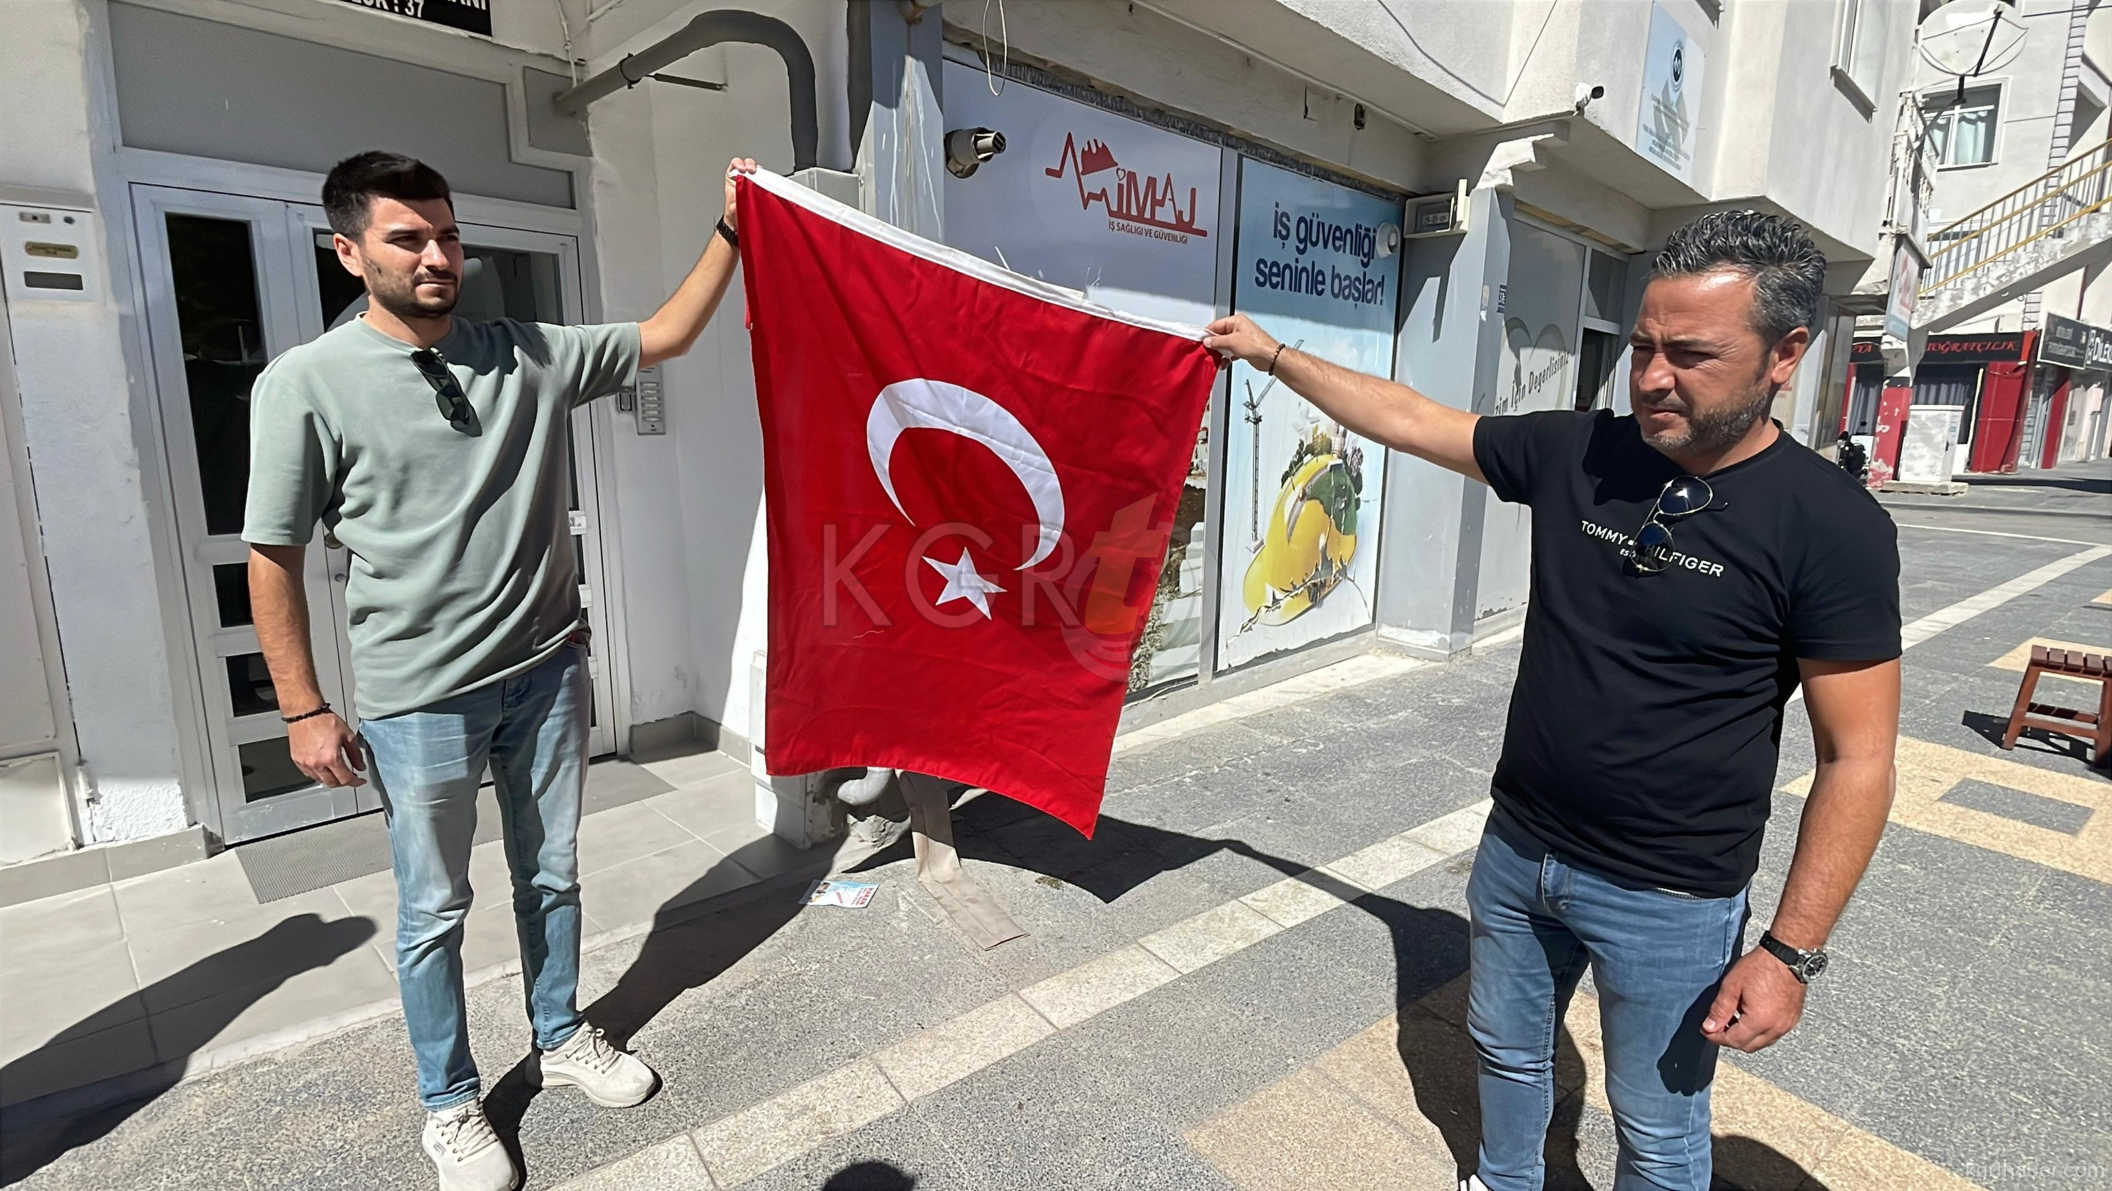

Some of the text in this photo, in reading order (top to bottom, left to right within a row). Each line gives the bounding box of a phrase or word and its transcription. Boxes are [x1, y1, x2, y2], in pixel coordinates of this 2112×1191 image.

[404, 0, 424, 18] 37
[1273, 201, 1377, 269] iş güvenliği
[1254, 257, 1385, 310] seninle başlar!
[1580, 519, 1629, 546] TOMMY
